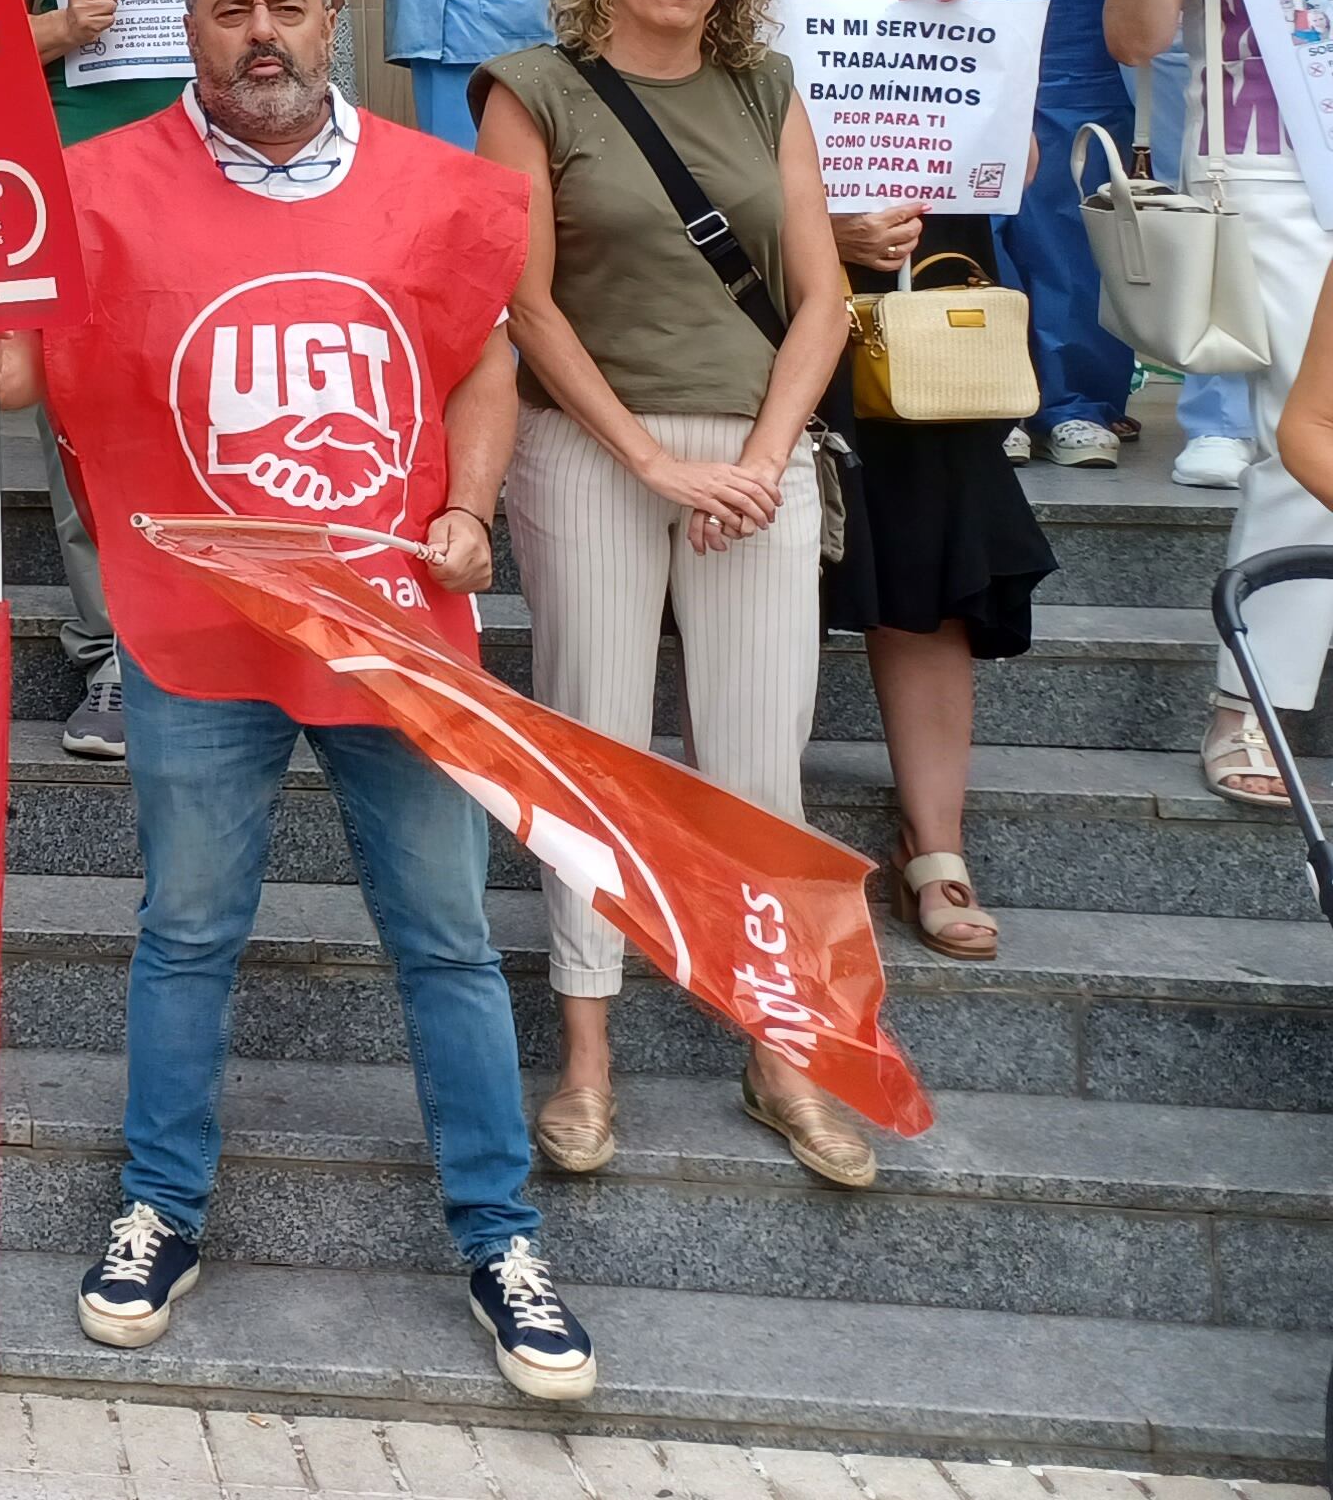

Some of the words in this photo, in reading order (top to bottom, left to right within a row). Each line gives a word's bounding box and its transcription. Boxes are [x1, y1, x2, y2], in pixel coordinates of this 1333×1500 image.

[806, 18, 834, 35] EN
[843, 19, 868, 36] MI
[876, 20, 996, 44] SERVICIO
[818, 51, 977, 73] TRABAJAMOS
[810, 83, 863, 100] BAJO
[869, 80, 981, 106] MÍNIMOS
[833, 112, 870, 125] PEOR
[874, 112, 920, 126] PARA
[927, 114, 945, 128] TI
[825, 135, 865, 148] COMO
[870, 135, 952, 151] USUARIO
[822, 157, 862, 171] PEOR
[867, 157, 920, 172] PARA
[927, 160, 952, 174] MI
[865, 183, 957, 199] LABORAL
[208, 322, 392, 430] UGT
